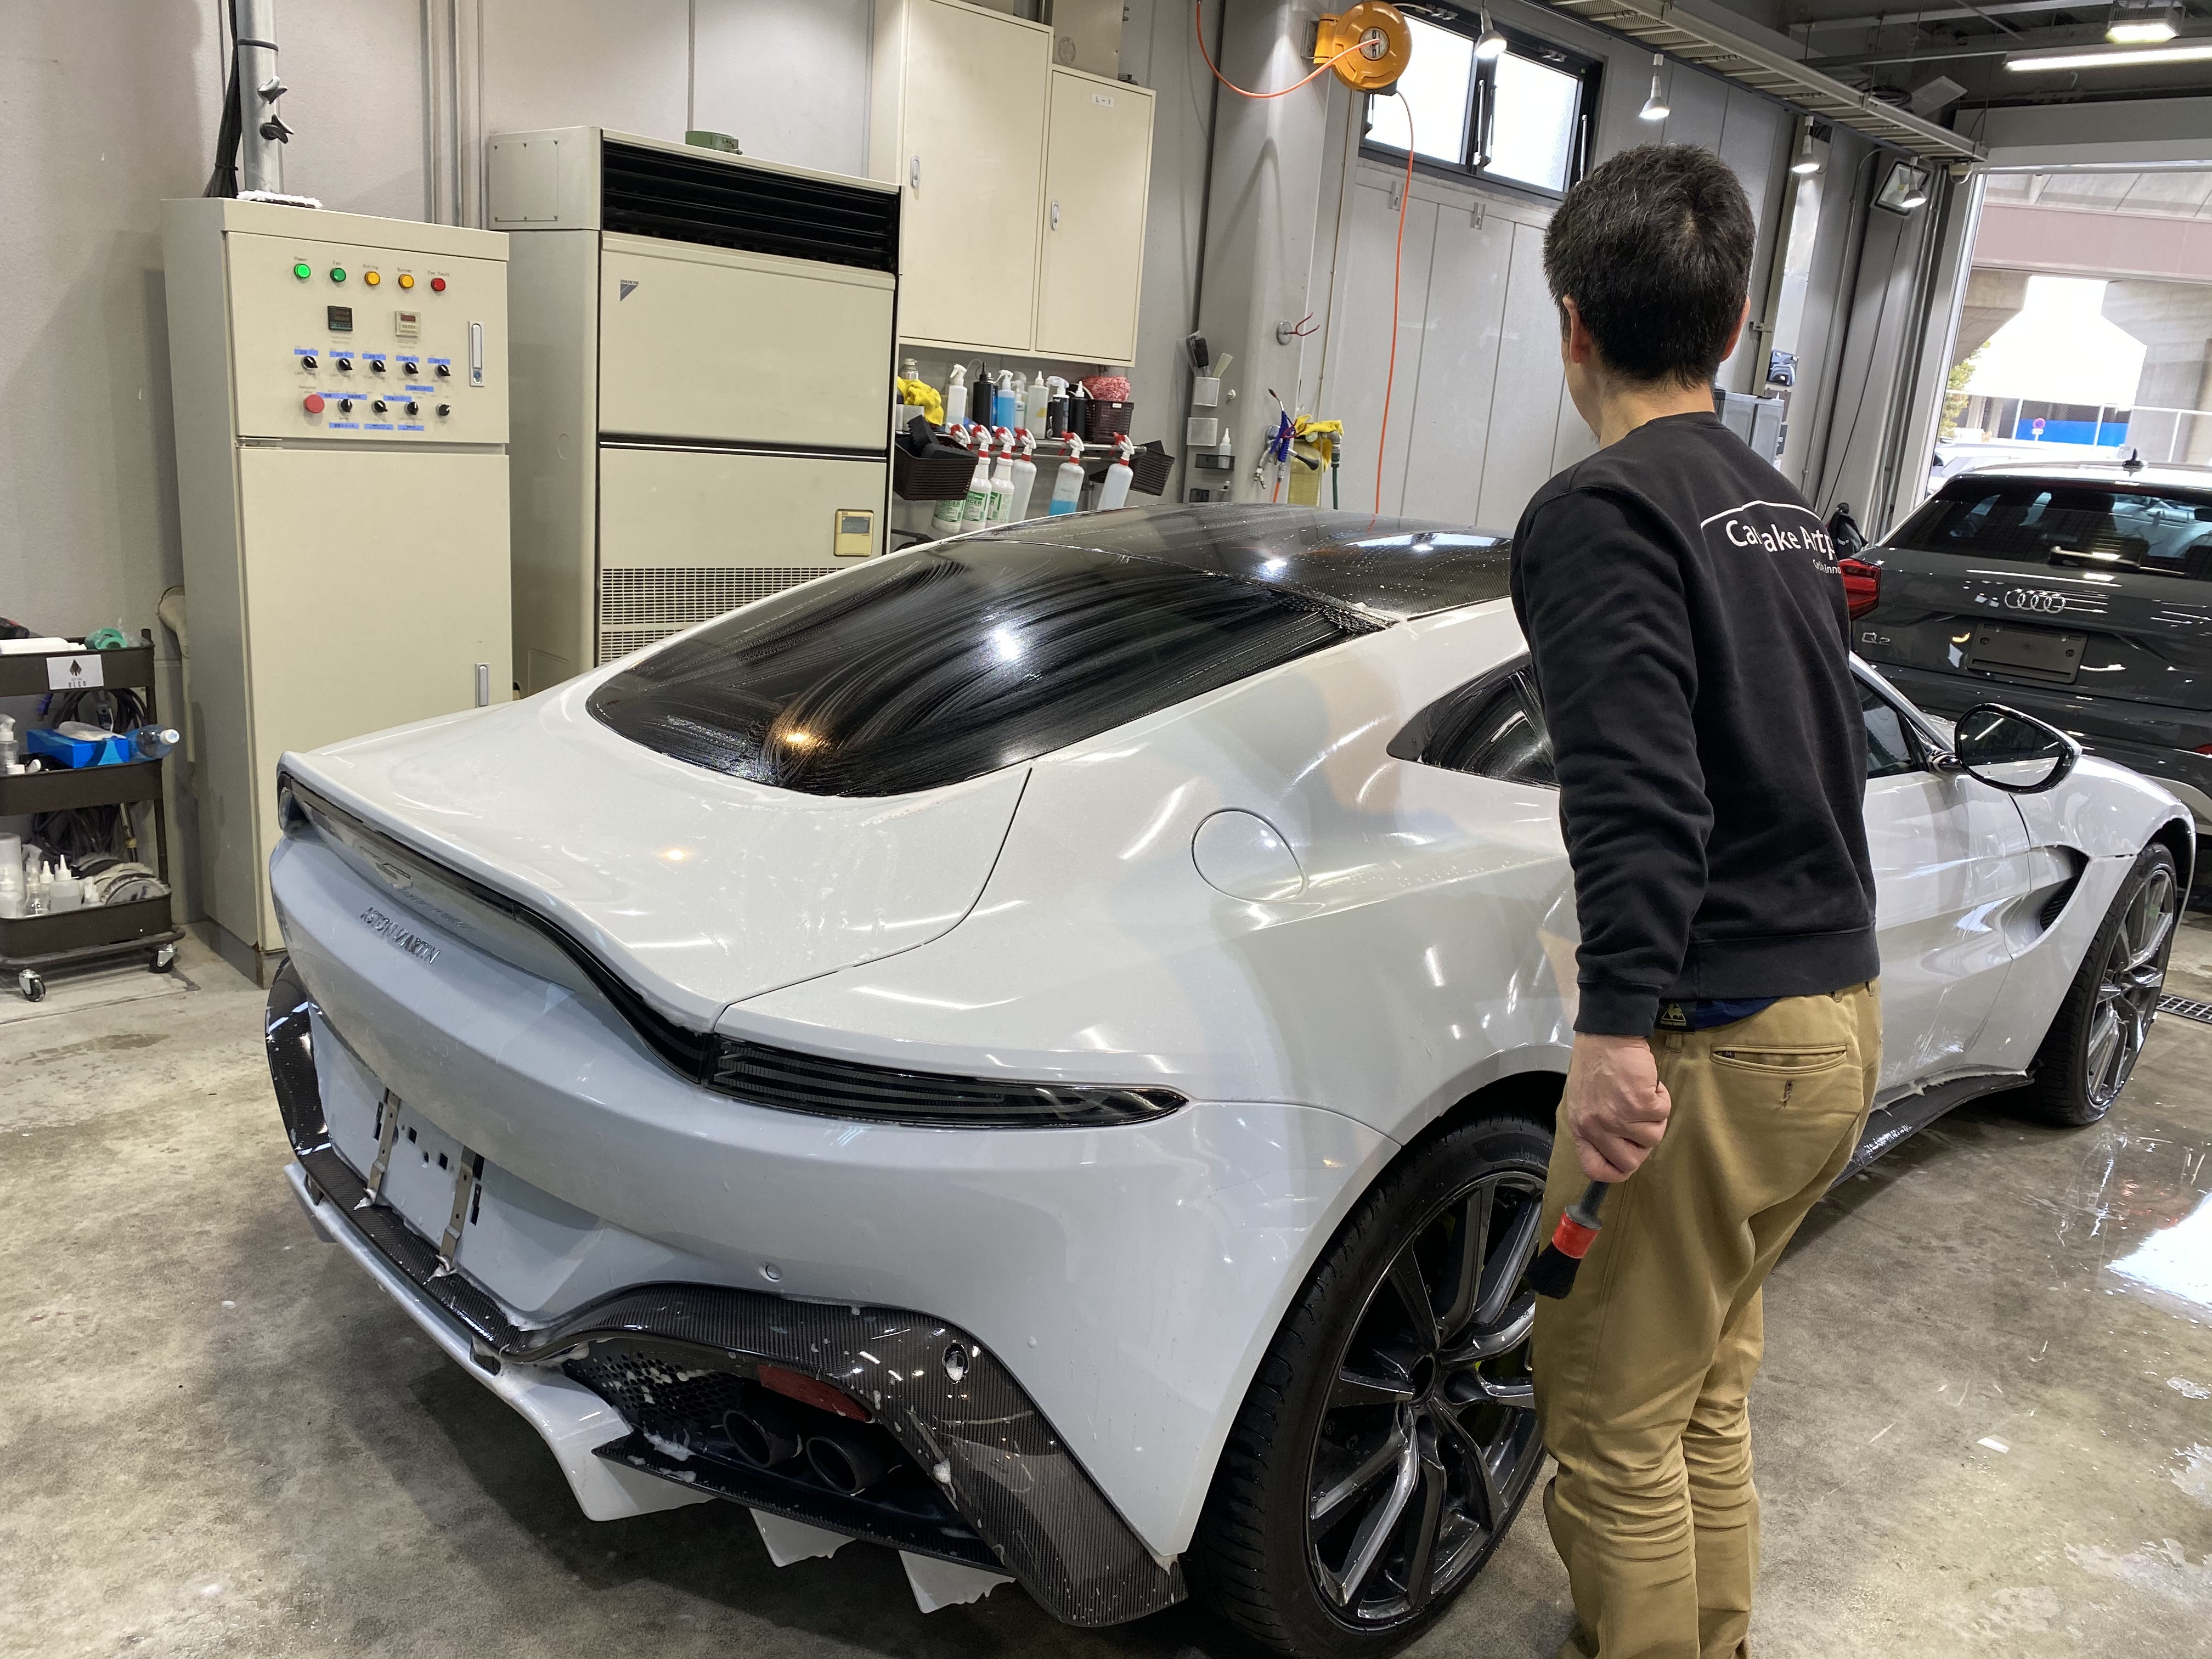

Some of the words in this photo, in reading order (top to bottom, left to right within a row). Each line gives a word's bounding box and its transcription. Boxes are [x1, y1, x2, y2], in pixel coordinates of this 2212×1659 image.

[1862, 632, 1891, 646] Q2
[360, 907, 398, 936] ASTON
[392, 928, 441, 964] MARTIN
